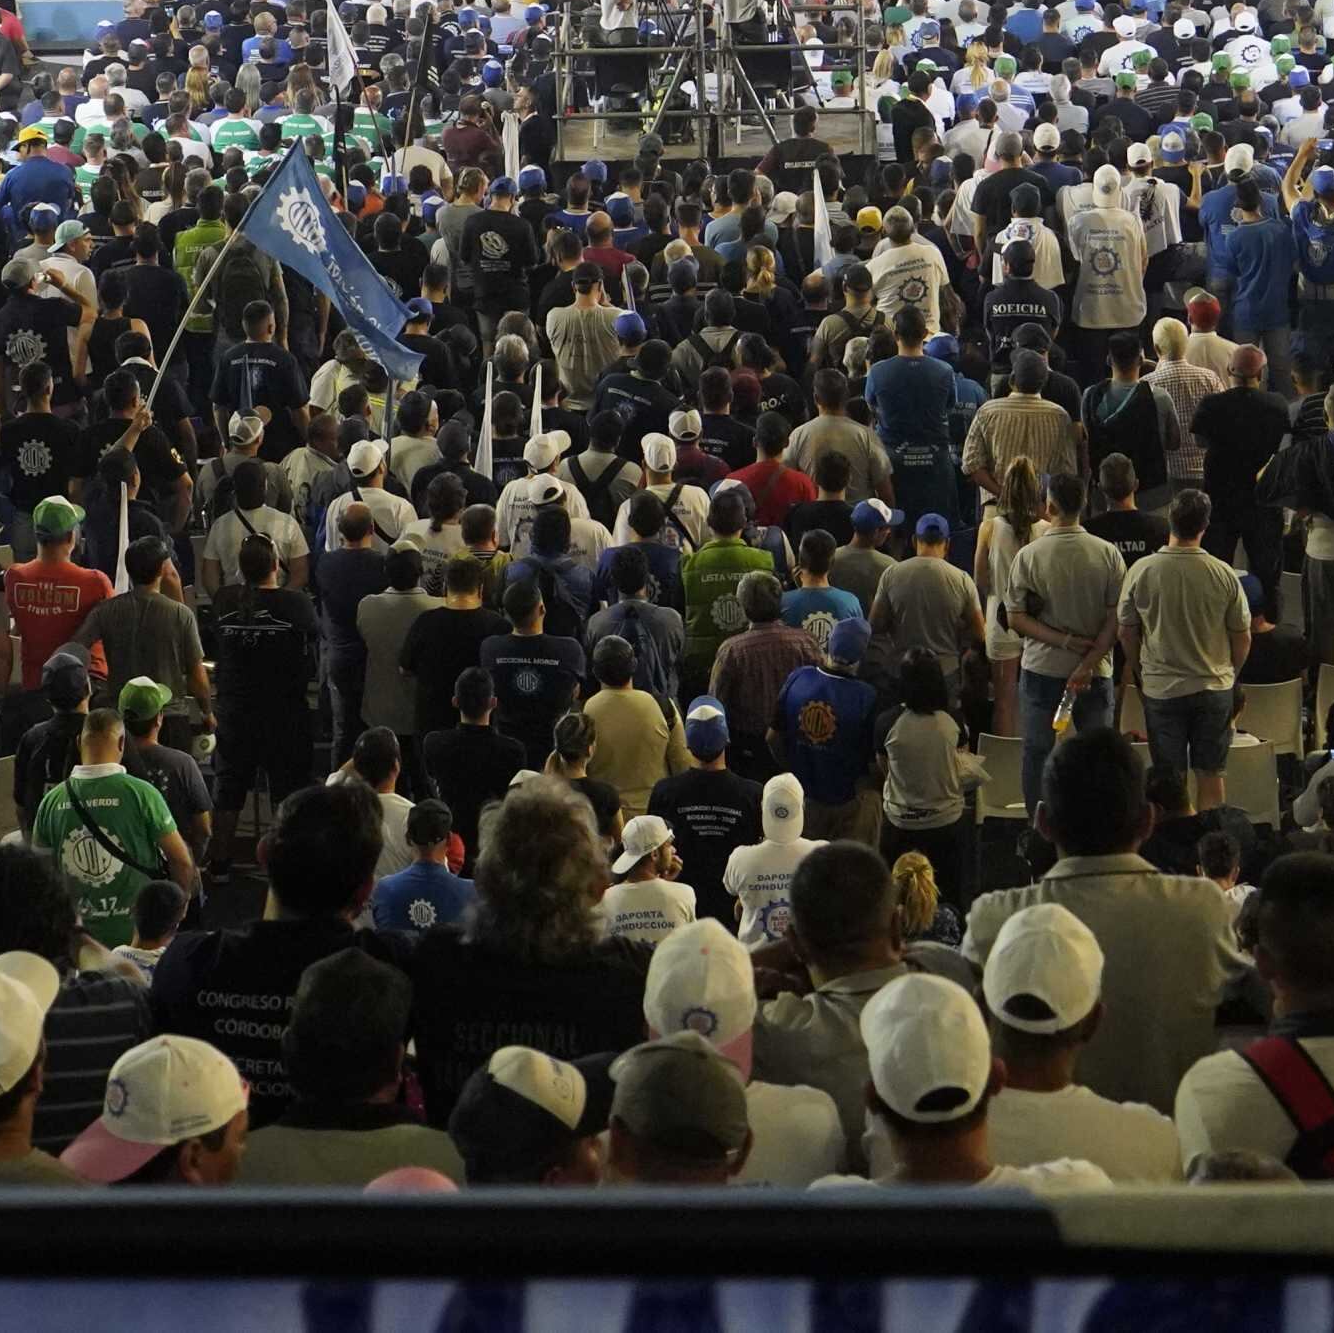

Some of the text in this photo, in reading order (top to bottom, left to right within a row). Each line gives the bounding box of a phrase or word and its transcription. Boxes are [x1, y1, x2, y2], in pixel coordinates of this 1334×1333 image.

[991, 303, 1047, 316] SOEICHA
[84, 797, 120, 809] VERDE
[197, 990, 284, 1010] CONGRESO
